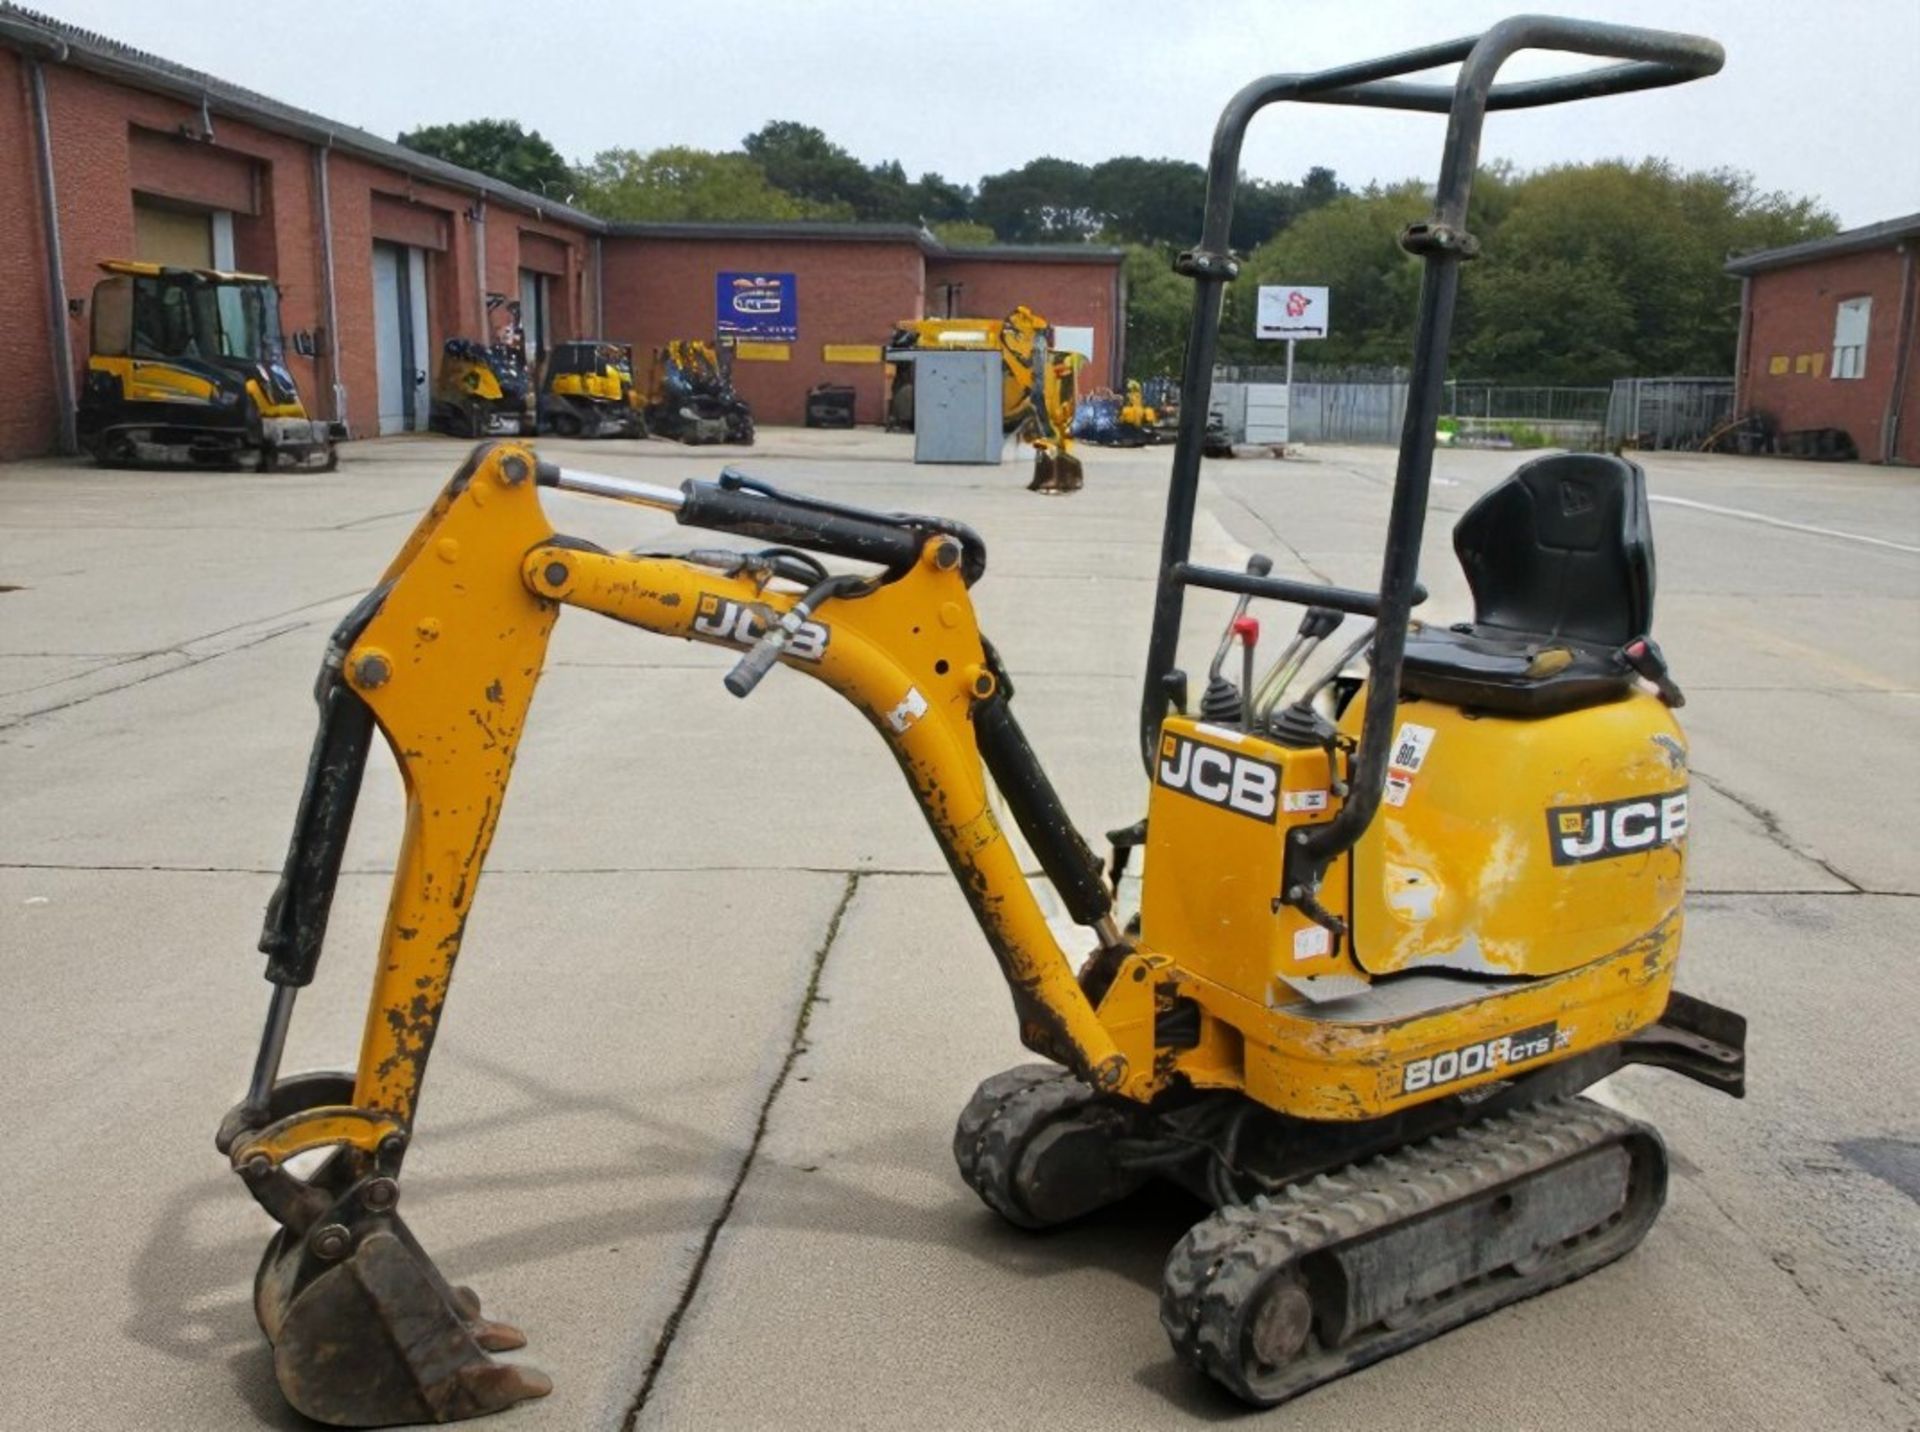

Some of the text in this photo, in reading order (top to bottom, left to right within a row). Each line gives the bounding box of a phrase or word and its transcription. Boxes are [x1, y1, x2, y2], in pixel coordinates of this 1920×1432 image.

[695, 602, 827, 659] JCB
[1161, 741, 1277, 817] JCB
[1561, 793, 1688, 857] JCB
[1510, 1037, 1550, 1062] CTS
